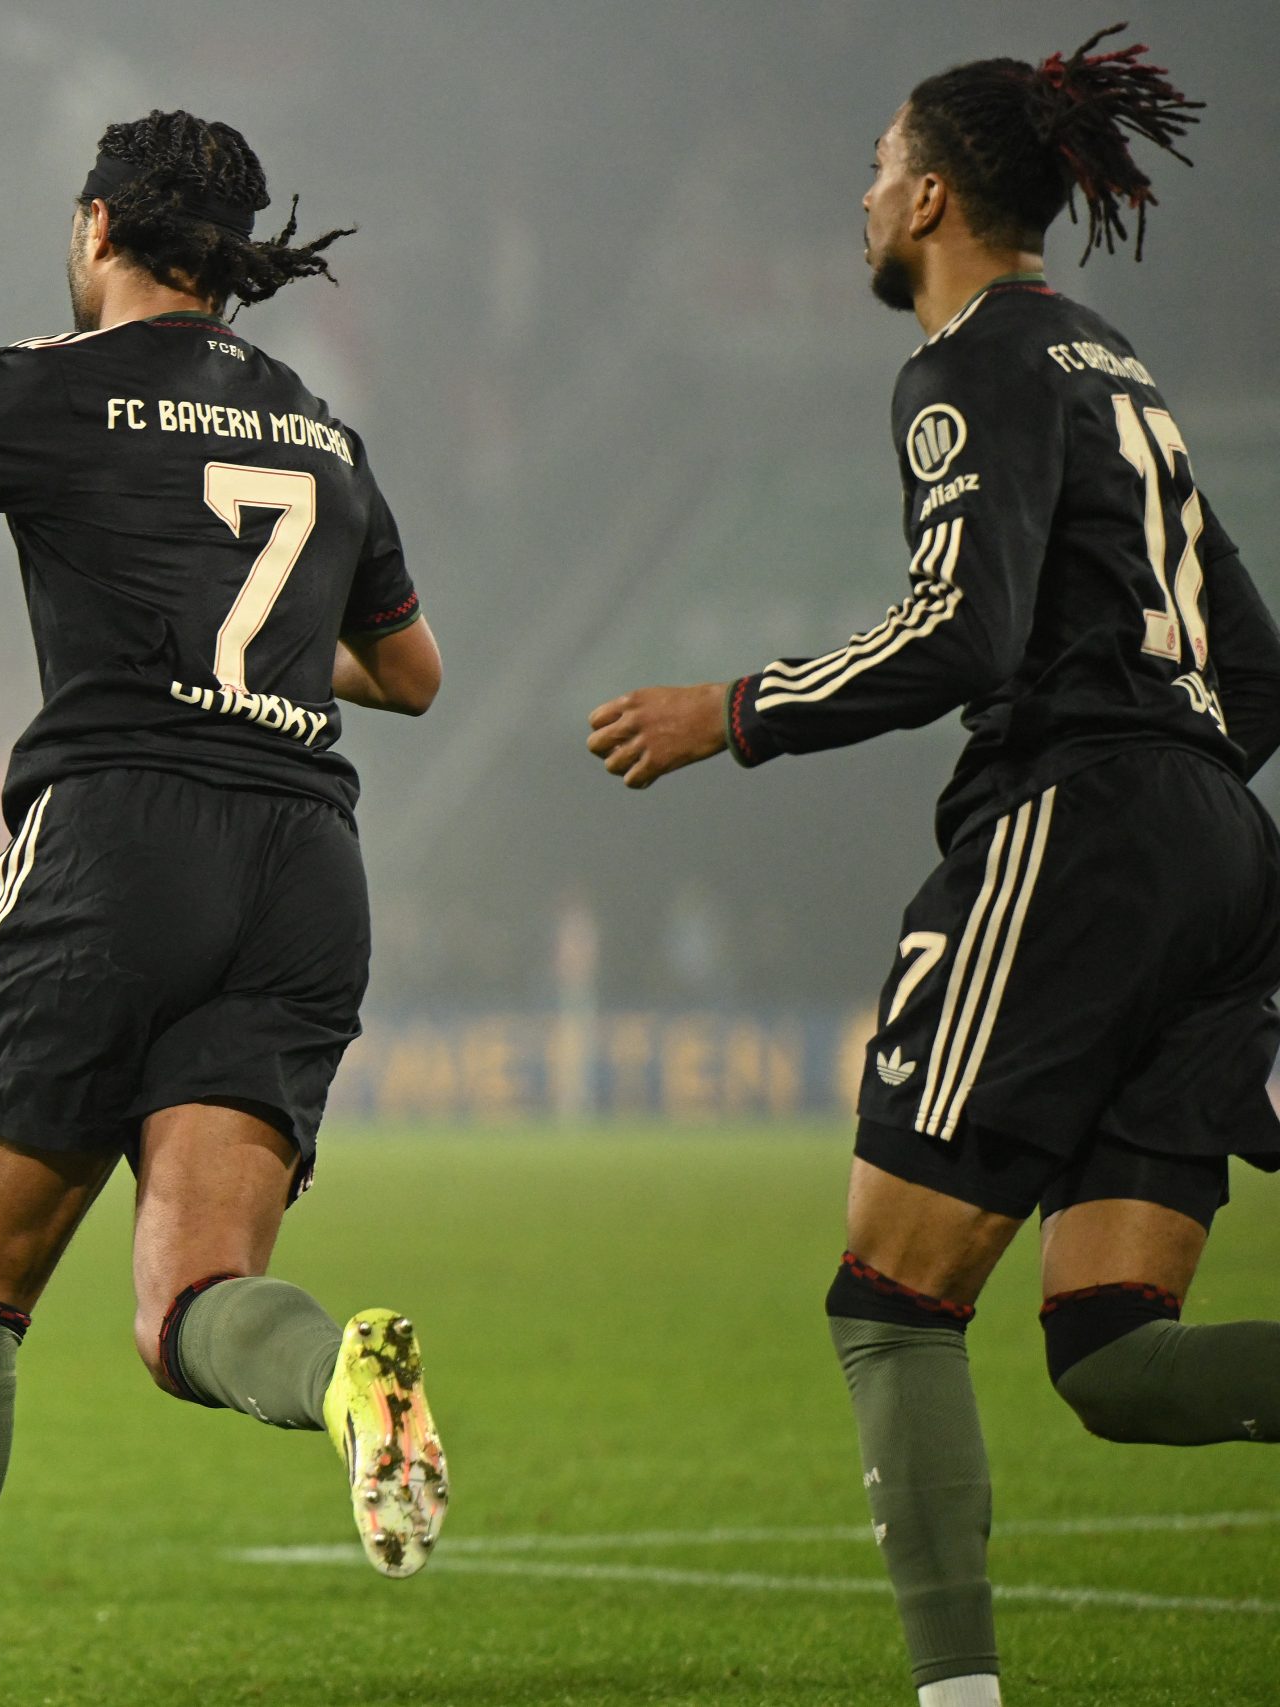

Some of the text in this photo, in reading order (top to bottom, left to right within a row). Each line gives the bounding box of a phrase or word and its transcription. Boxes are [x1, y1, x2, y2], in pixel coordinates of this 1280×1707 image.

[1047, 344, 1085, 373] FC
[107, 398, 147, 429] FC
[158, 399, 262, 440] BAYERN
[204, 461, 316, 694] 7
[886, 930, 947, 1027] 7
